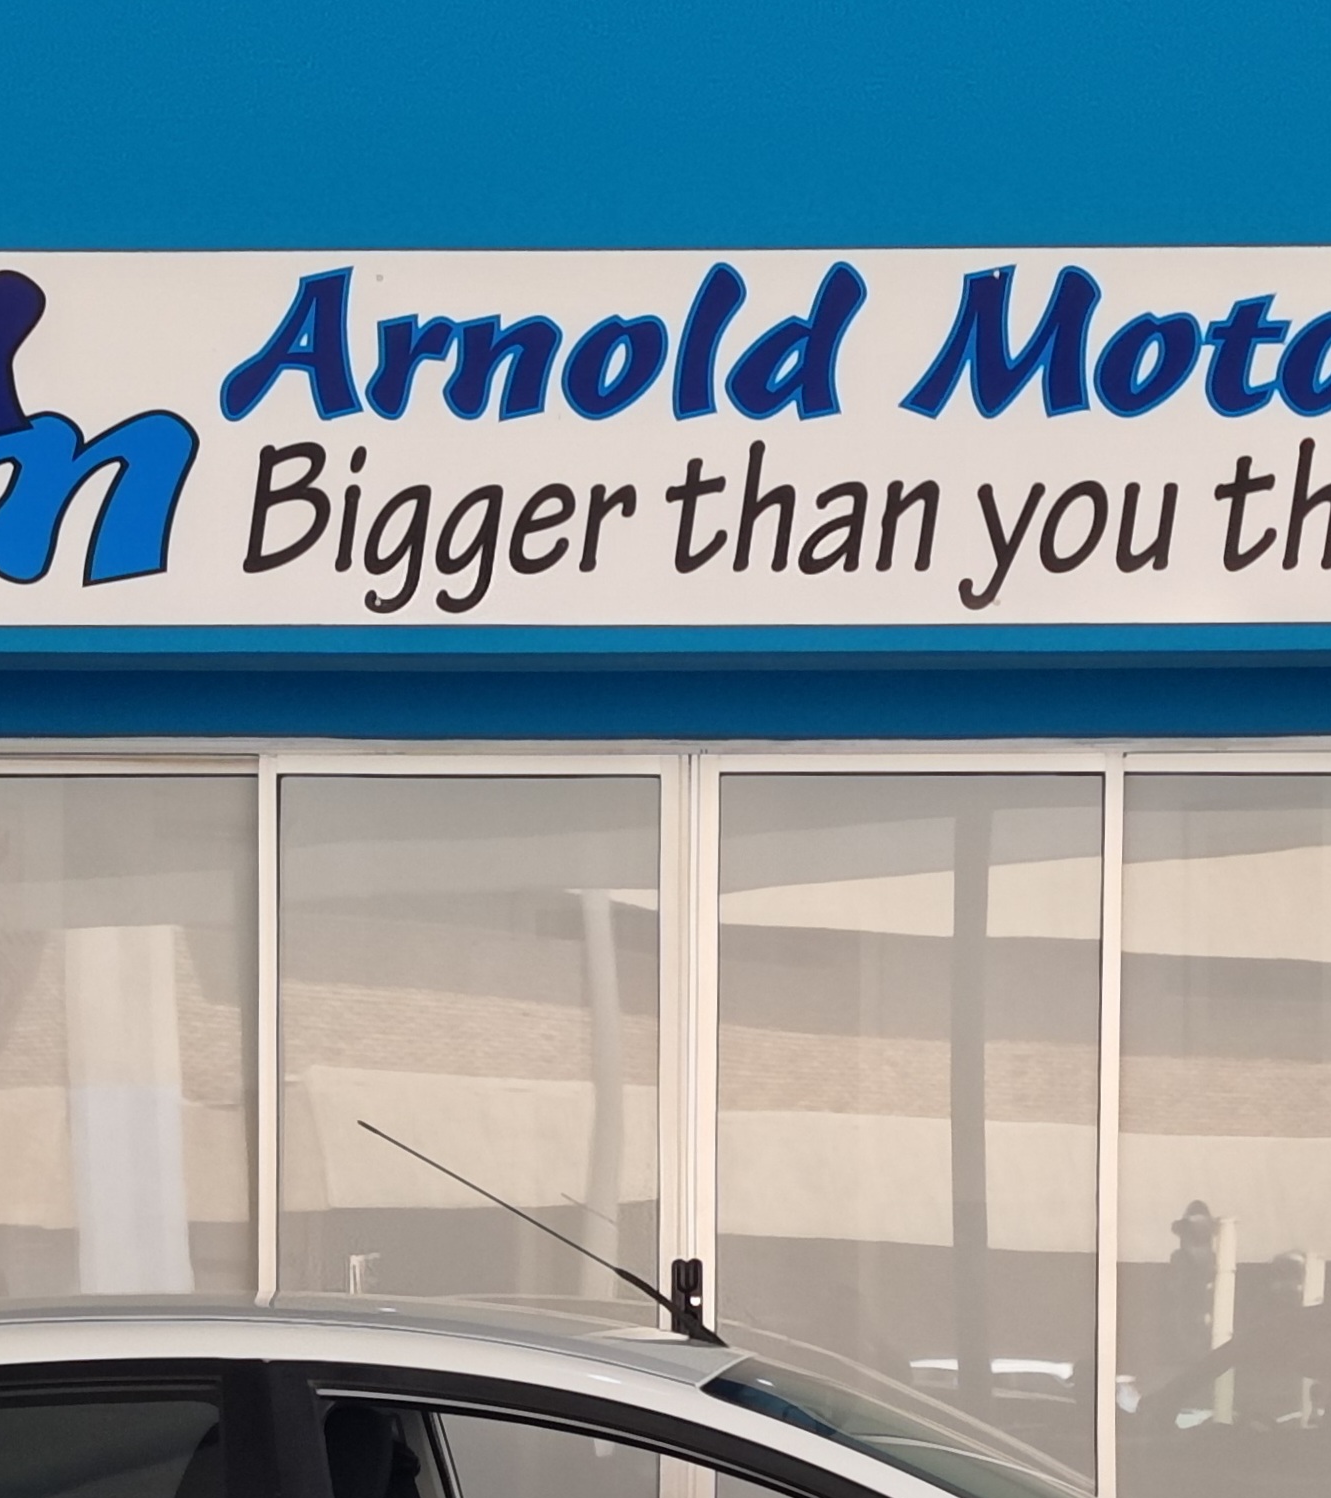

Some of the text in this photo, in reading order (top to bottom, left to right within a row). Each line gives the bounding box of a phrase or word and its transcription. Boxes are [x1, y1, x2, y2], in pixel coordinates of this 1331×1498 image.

[219, 260, 868, 422] Arnold
[242, 441, 637, 614] Bigger
[665, 438, 941, 576] than
[958, 480, 1180, 611] you
